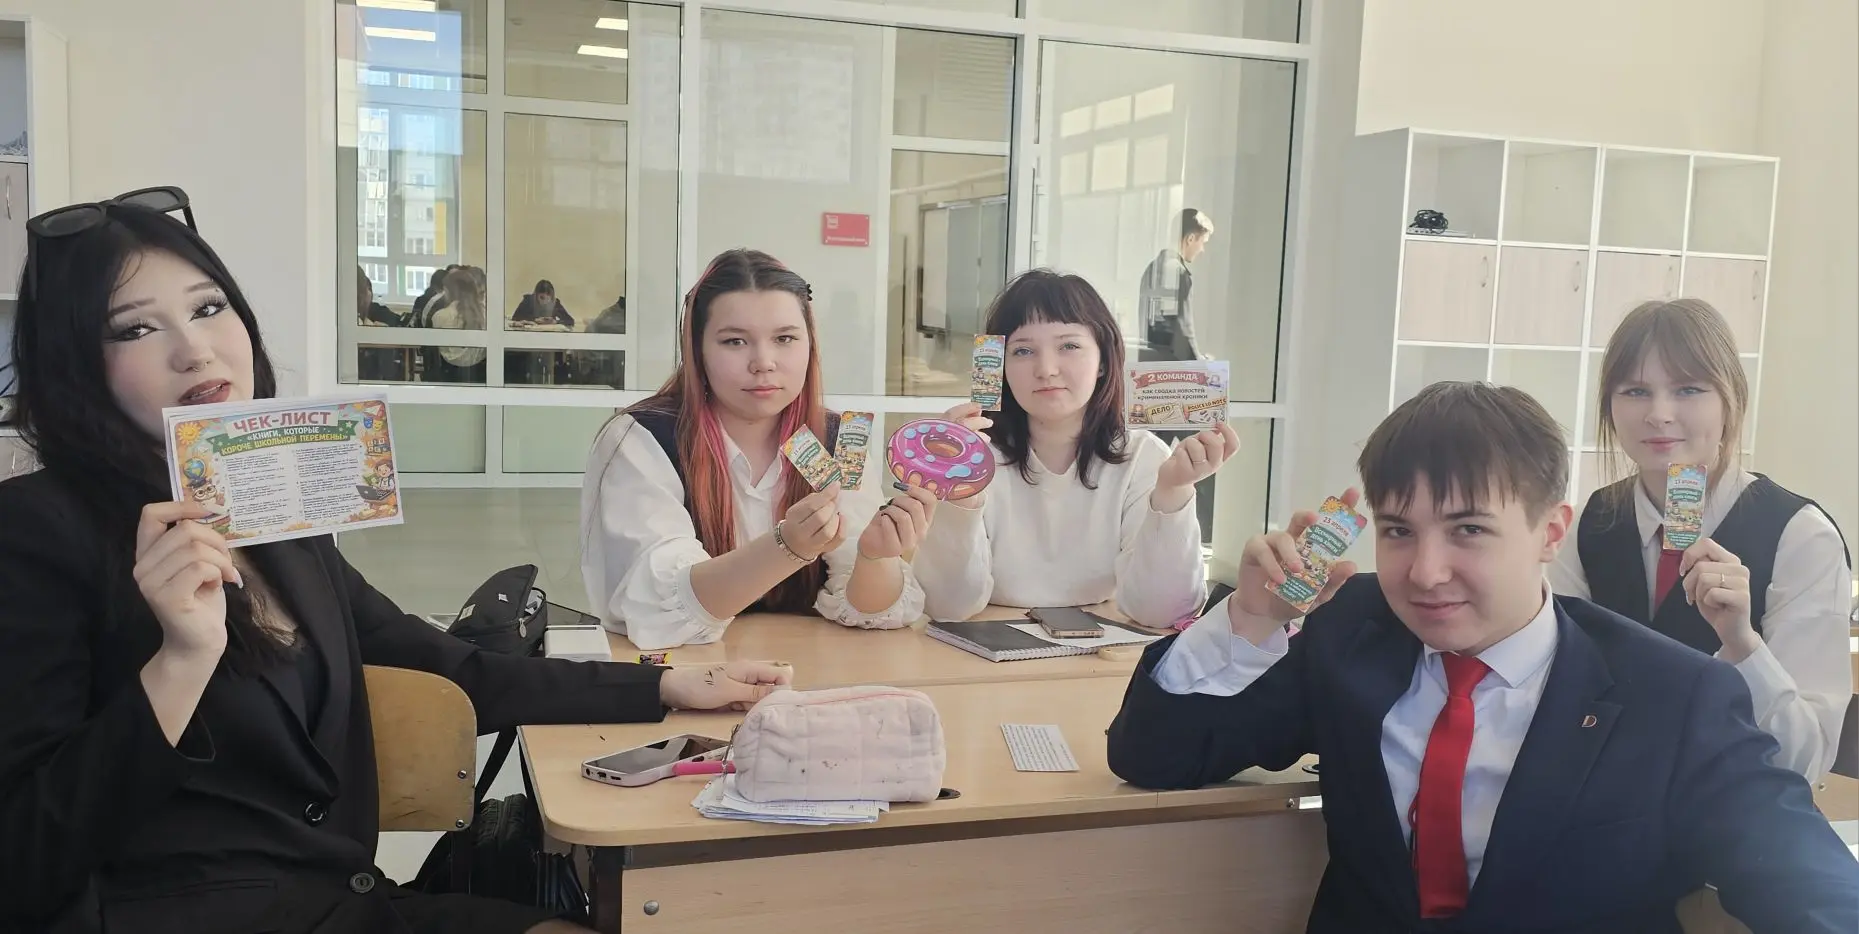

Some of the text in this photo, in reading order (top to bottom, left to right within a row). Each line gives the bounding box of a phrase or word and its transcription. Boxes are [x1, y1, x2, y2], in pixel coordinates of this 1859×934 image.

[1147, 373, 1198, 383] 2 КОМАНДА
[233, 411, 332, 433] ЧЕК-ЛИСТ
[247, 426, 320, 441] «КНИГИ, КОТОРЫЕ
[221, 433, 348, 456] КОРОЧЕ ШКОЛЬНОЙ ПЕРЕМЕНЫ»
